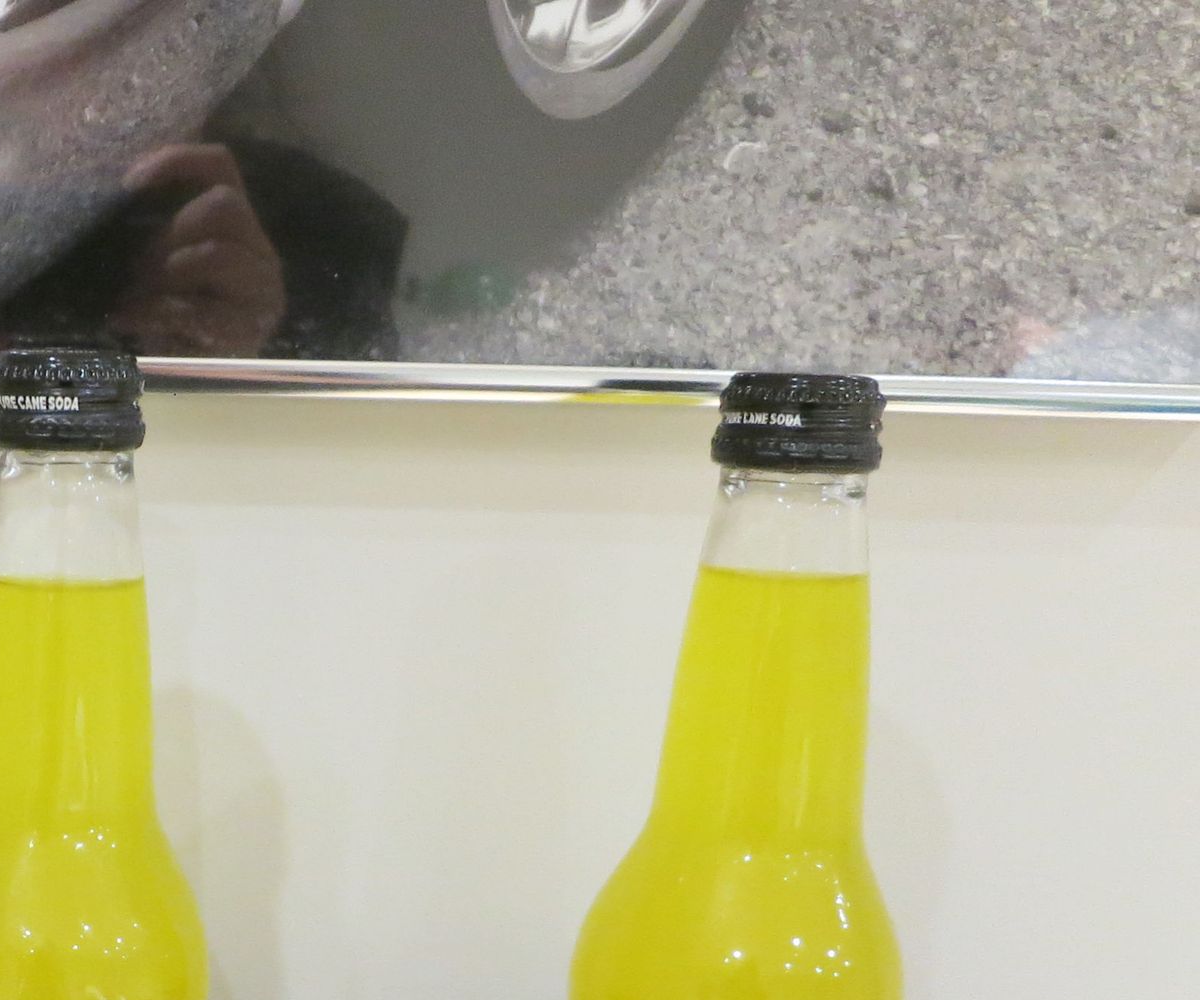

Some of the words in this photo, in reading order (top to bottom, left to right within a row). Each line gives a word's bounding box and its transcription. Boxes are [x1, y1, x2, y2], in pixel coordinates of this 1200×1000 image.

[18, 396, 47, 410] CANE
[48, 396, 79, 411] SODA
[770, 413, 802, 427] SODA
